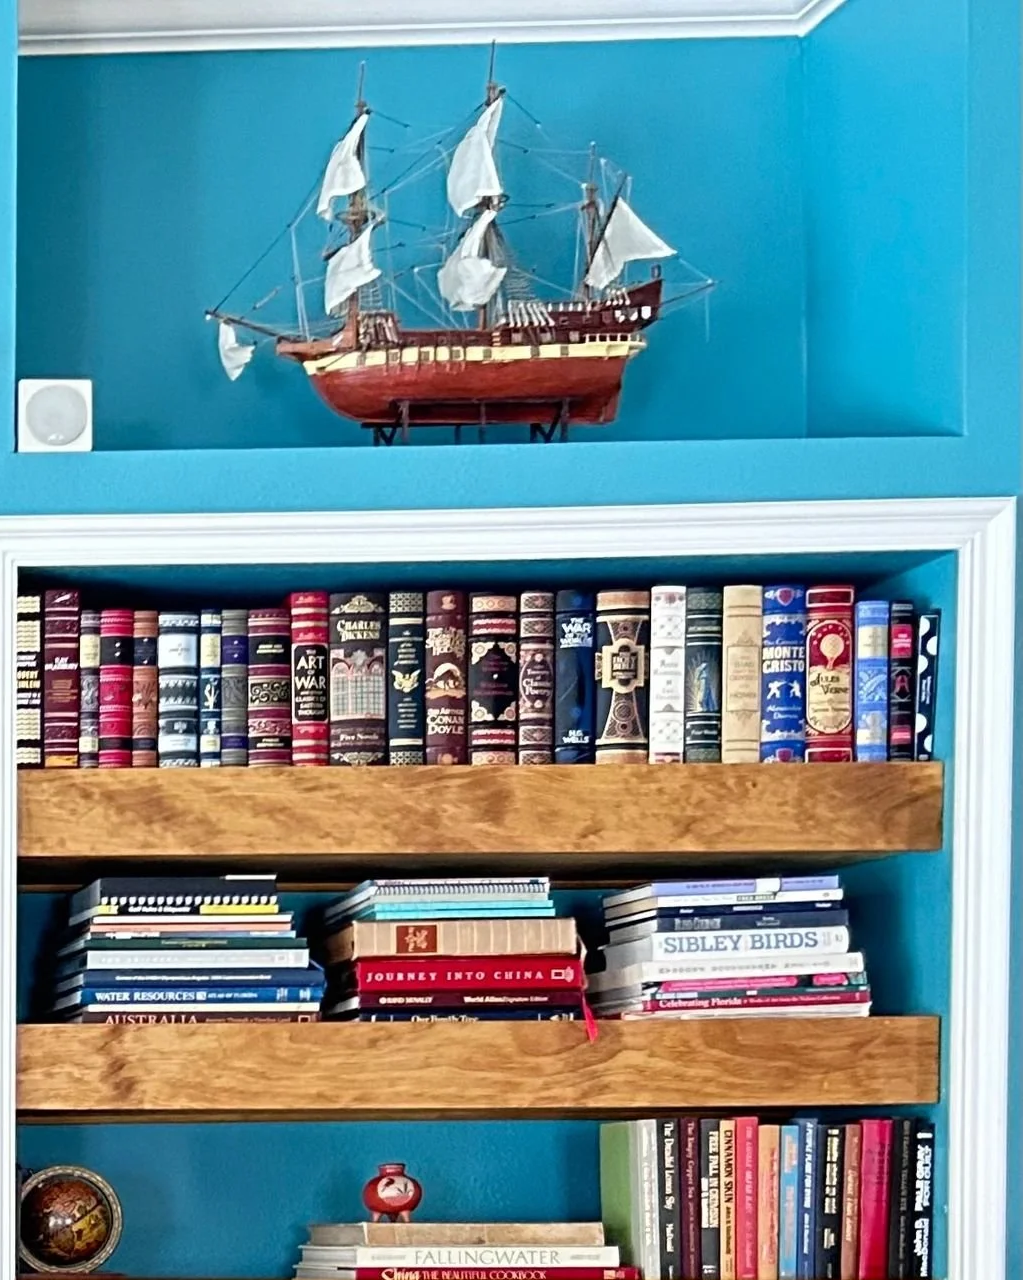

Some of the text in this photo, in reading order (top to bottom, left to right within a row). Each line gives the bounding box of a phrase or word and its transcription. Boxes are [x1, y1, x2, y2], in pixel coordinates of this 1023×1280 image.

[562, 623, 591, 634] WAR
[340, 630, 380, 642] DICKENS
[763, 647, 806, 660] MONTE
[297, 656, 325, 670] ART
[763, 660, 806, 674] CRISTO
[295, 676, 326, 690] WAR
[427, 715, 465, 725] CONAN
[428, 725, 465, 735] DOYLE
[563, 736, 590, 744] WELLS
[664, 932, 819, 953] SIBLEY BIRDS
[366, 971, 545, 983] JOURNEY INTO CHINA
[95, 992, 195, 1001] WATER RESOURCES
[659, 998, 710, 1009] Celebrating
[711, 997, 743, 1007] Florida
[105, 1014, 197, 1024] AUSTRALIA
[664, 1122, 673, 1137] The
[724, 1130, 733, 1204] CINNAMON SKIN
[916, 1144, 925, 1179] GRAY
[686, 1160, 695, 1185] Copper
[709, 1131, 719, 1228] FREE FALL IN CRIMSON
[923, 1145, 932, 1206] FOR GUILT
[665, 1170, 674, 1194] Lemon
[664, 1196, 675, 1210] Sky
[914, 1230, 923, 1256] John
[920, 1218, 930, 1277] MacDonald
[415, 1250, 561, 1265] FALLINGWATER
[382, 1268, 547, 1280] China THE BEAUTIFUL COOKBOOK
